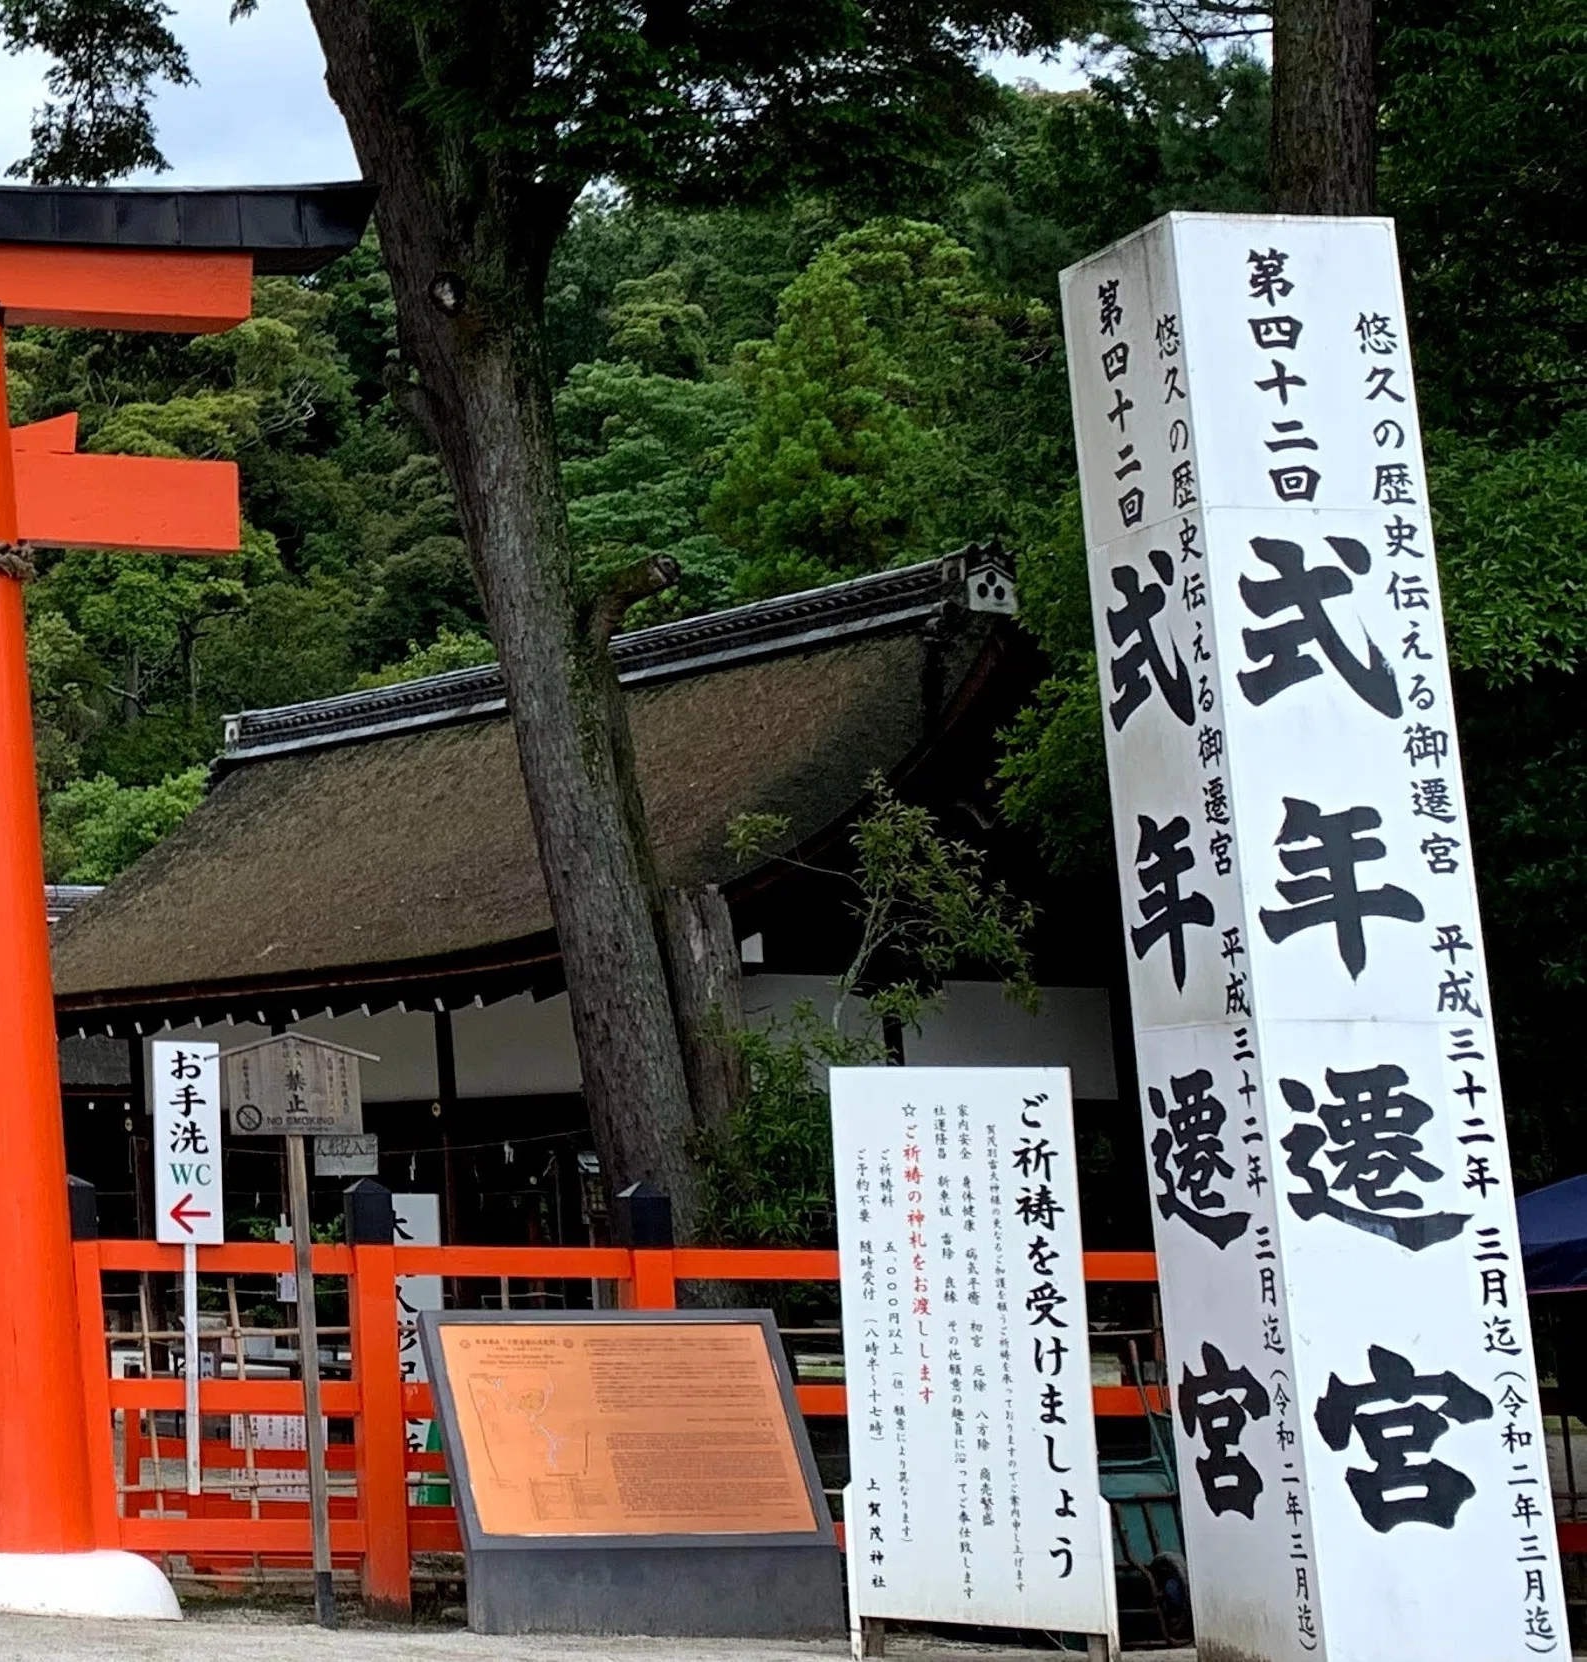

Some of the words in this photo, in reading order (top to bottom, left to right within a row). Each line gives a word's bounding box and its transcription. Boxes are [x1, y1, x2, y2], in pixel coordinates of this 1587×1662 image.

[1098, 279, 1145, 528] 第四十二回
[1247, 248, 1321, 502] 第四十二回
[1107, 550, 1270, 1521] 式年遷宮
[1237, 535, 1494, 1533] 式年遷宮
[169, 1049, 210, 1154] お手洗
[267, 1116, 283, 1126] NO
[286, 1116, 335, 1126] SMOKING
[285, 1070, 309, 1113] 禁止
[957, 1104, 971, 1160] 家内安全
[169, 1162, 212, 1187] WC
[856, 1148, 871, 1223] ご予約不要
[879, 1148, 894, 1208] ご祈祷料
[934, 1104, 948, 1159] 社運隆昌
[944, 1276, 958, 1304] 良縁
[962, 1175, 976, 1232] 身体健康
[859, 1240, 876, 1301] 随時受付
[966, 1247, 980, 1305] 病気平癒
[970, 1320, 983, 1348] 初宮
[1012, 1092, 1075, 1579] ご祈祷を受けましょう
[973, 1365, 987, 1392] 厄除
[975, 1410, 990, 1451] 八方除
[980, 1467, 994, 1526] 商売繁盛
[866, 1477, 886, 1589] 上賀茂神社
